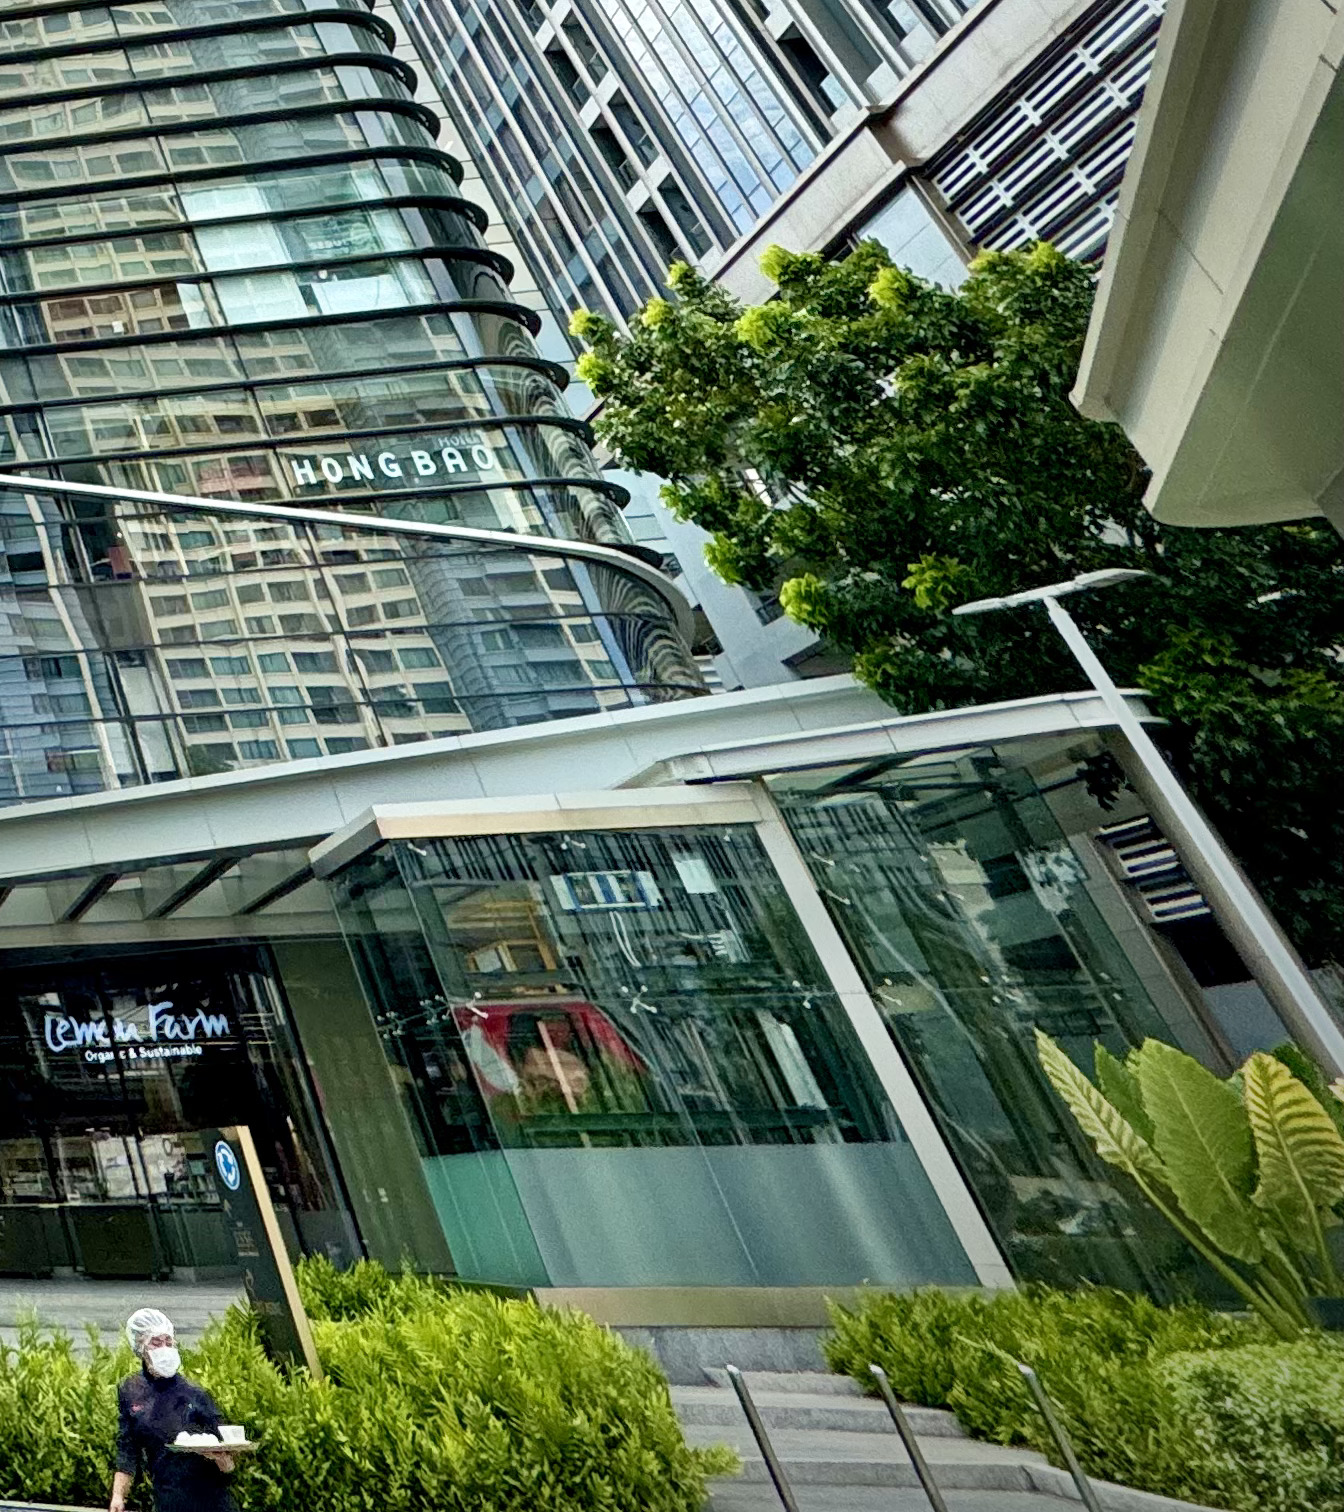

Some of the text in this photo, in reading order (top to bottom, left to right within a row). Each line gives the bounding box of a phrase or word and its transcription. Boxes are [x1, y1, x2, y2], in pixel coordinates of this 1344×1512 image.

[291, 447, 495, 485] HONG BAO
[149, 1001, 230, 1042] Farm
[139, 1043, 203, 1059] Sustainable
